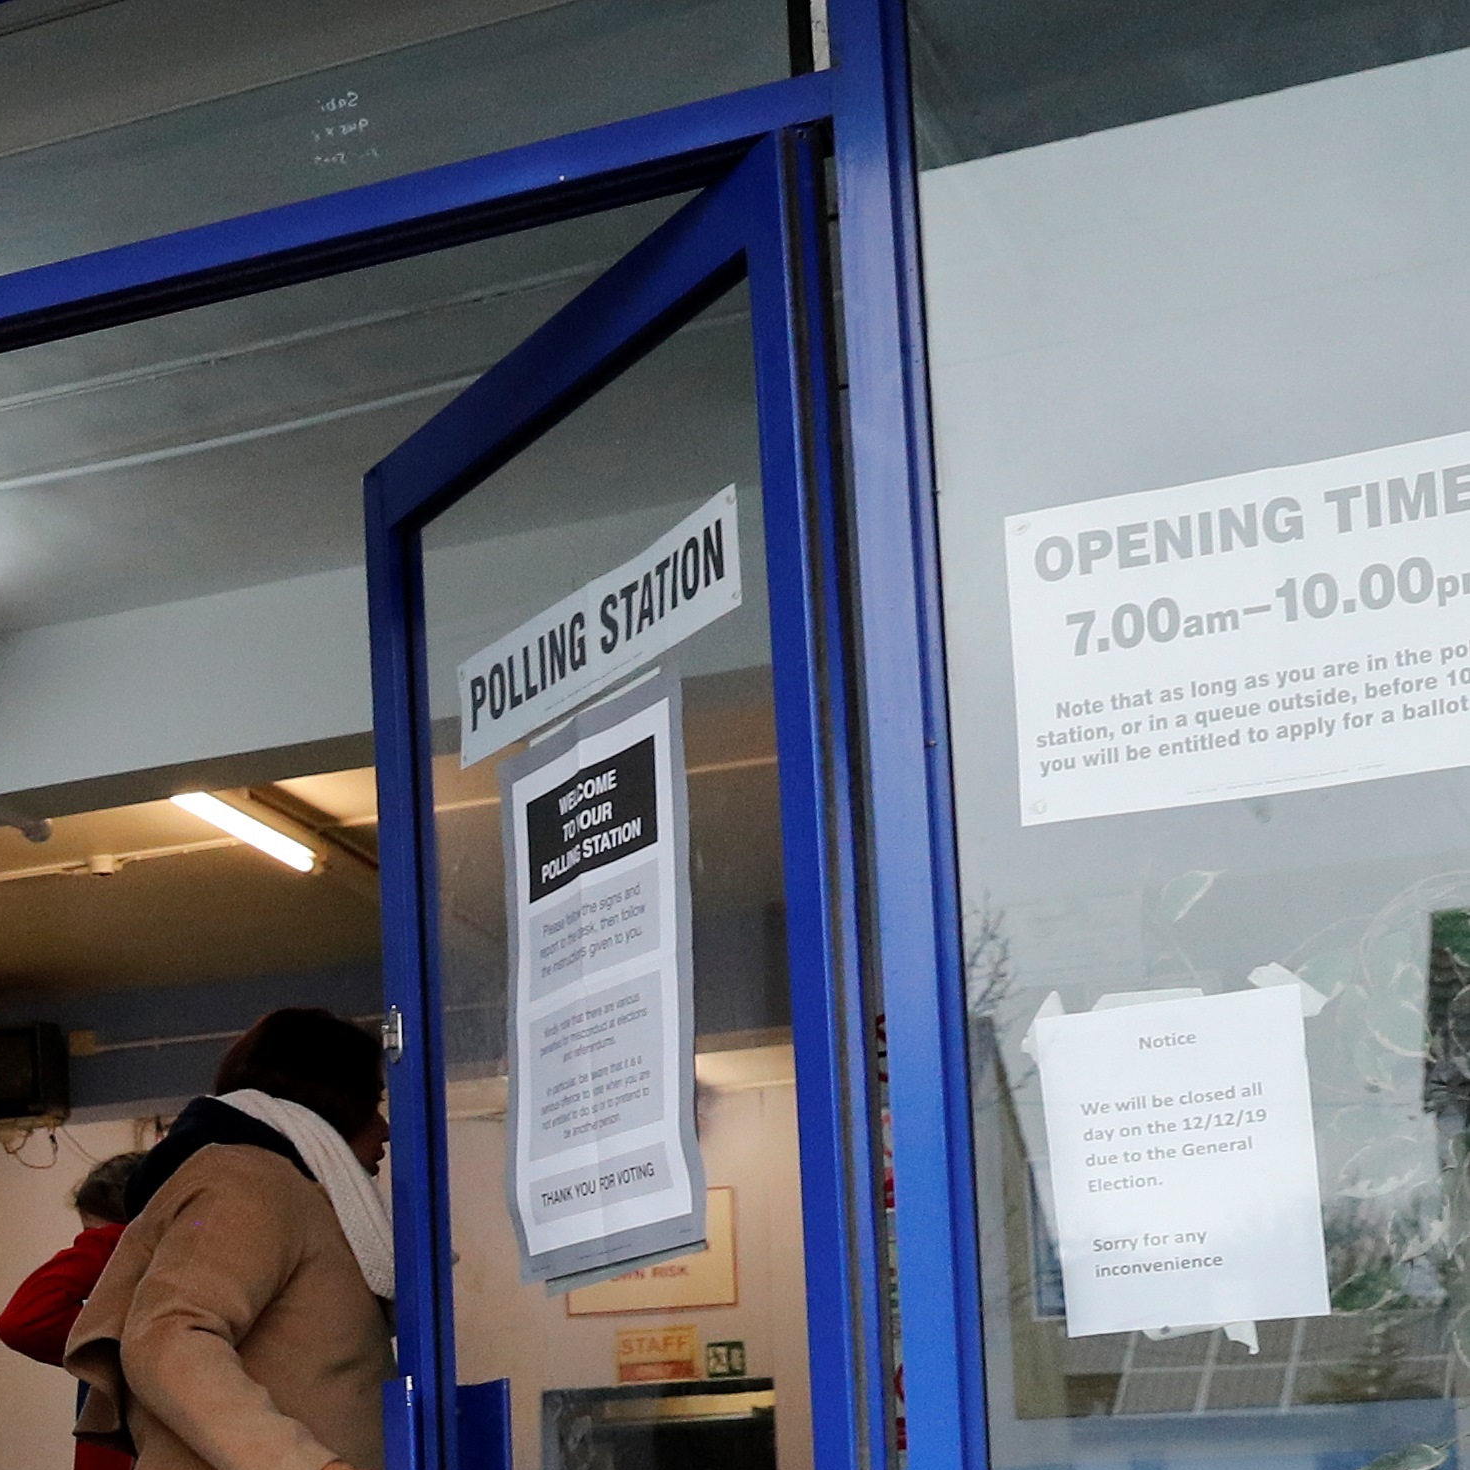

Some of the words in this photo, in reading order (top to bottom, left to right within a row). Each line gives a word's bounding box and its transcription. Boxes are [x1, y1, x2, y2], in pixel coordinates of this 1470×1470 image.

[1034, 497, 1305, 582] OPENING
[1323, 463, 1470, 533] TIME
[470, 611, 587, 732] POLLING
[599, 518, 724, 654] STATION
[1056, 698, 1104, 719] Note
[1110, 688, 1153, 710] that
[1159, 686, 1184, 703] as
[1190, 678, 1237, 699] long
[1244, 673, 1270, 690] as
[1276, 666, 1315, 688] you
[1322, 660, 1360, 679] are
[1366, 654, 1388, 672] in
[1395, 648, 1433, 667] the
[1439, 639, 1470, 665] po
[1036, 724, 1114, 748] station,
[1121, 719, 1143, 736] or
[1148, 714, 1168, 732] in
[1175, 713, 1188, 728] a
[1195, 702, 1261, 727] queue
[1268, 687, 1357, 713] outside,
[1364, 675, 1438, 700] before
[1039, 756, 1076, 778] you
[1082, 746, 1119, 768] will
[1126, 744, 1152, 762] be
[1158, 728, 1240, 757] entitled
[1247, 726, 1269, 744] to
[1275, 716, 1336, 742] apply
[1342, 711, 1374, 730] for
[1381, 709, 1395, 724] a
[1402, 695, 1469, 720] ballot
[562, 819, 576, 842] TO
[582, 817, 642, 859] STATION
[1138, 1031, 1197, 1050] Notice
[1080, 1101, 1111, 1117] We
[1115, 1096, 1147, 1113] will
[1152, 1093, 1174, 1109] be
[1179, 1085, 1236, 1106] closed
[1241, 1082, 1262, 1099] all
[1083, 1127, 1114, 1143] day
[1119, 1125, 1142, 1138] on
[1147, 1119, 1177, 1135] the
[1182, 1108, 1268, 1132] 12/12/19
[1085, 1151, 1119, 1167] due
[1123, 1149, 1141, 1163] to
[1147, 1145, 1177, 1160] the
[1181, 1136, 1253, 1157] General
[541, 1183, 574, 1207] THANK
[574, 1180, 596, 1198] YOU
[599, 1172, 616, 1193] FOR
[616, 1162, 655, 1187] VOTING
[1087, 1174, 1164, 1193] Election.
[1092, 1236, 1138, 1253] Sorry
[1142, 1232, 1169, 1247] for
[1174, 1230, 1207, 1246] any
[1094, 1254, 1223, 1278] inconvenience
[621, 1335, 690, 1356] STAFF
